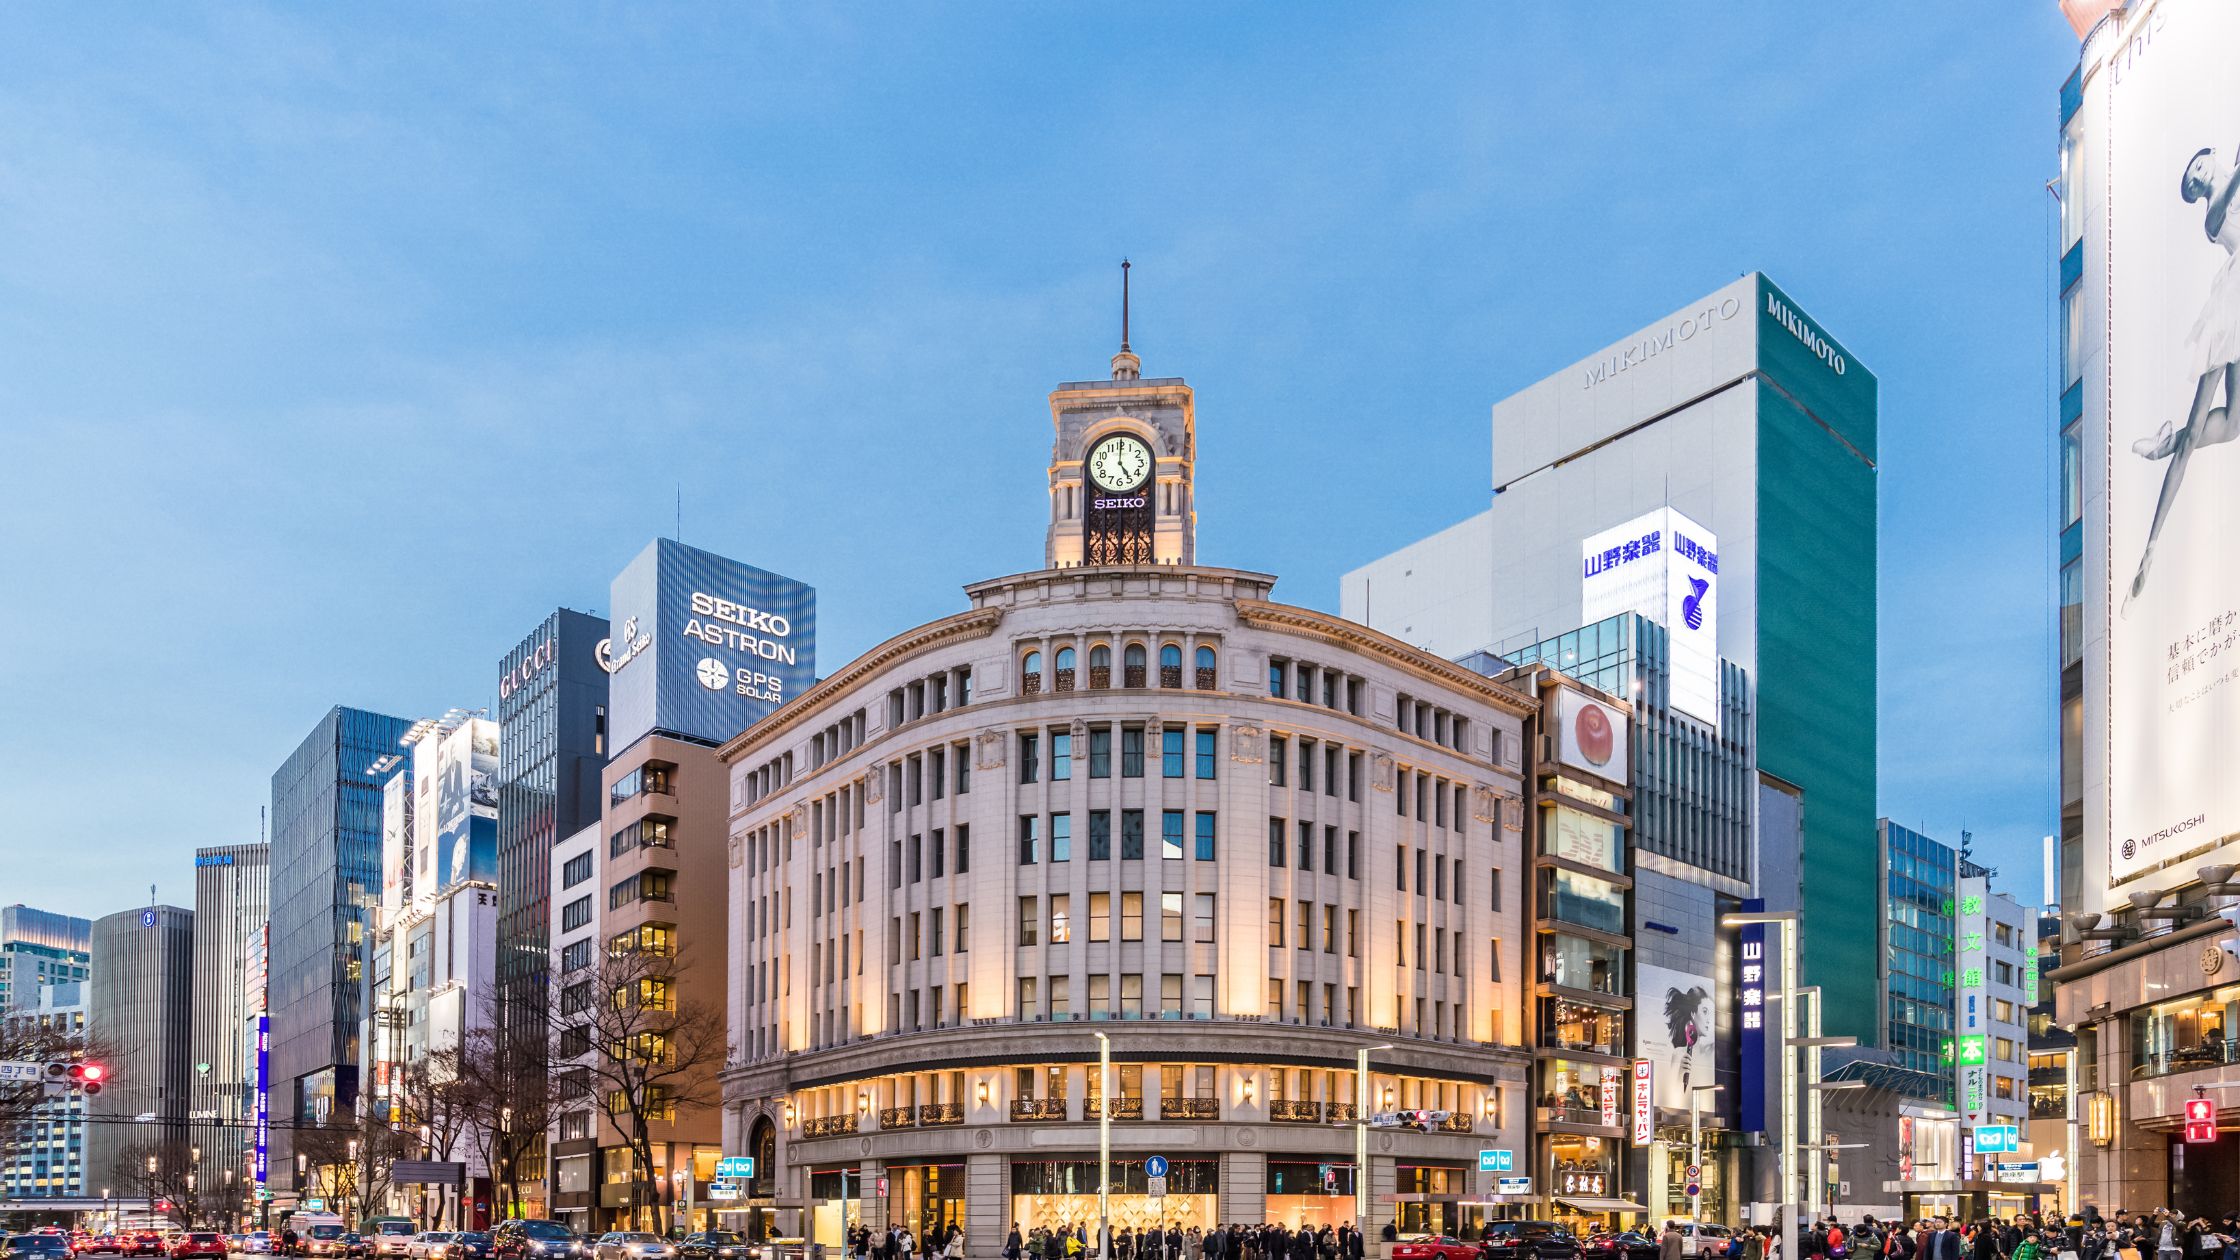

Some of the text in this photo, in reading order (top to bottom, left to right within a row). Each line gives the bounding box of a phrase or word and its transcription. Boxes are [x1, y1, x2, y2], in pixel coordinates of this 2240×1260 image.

[1583, 297, 1741, 389] MIKIMOTO
[1767, 292, 1846, 375] MIKIMOTO
[1099, 452, 1107, 460] 10
[1107, 444, 1114, 452] 11
[1135, 450, 1141, 458] 2
[1096, 461, 1103, 469] 9
[1099, 470, 1106, 478] 8
[1134, 468, 1141, 477] 4
[1138, 459, 1145, 468] 3
[1108, 476, 1114, 484] 7
[1116, 478, 1123, 486] 6
[1126, 475, 1133, 484] 5
[1094, 497, 1145, 509] SEIKO
[1584, 530, 1661, 578] 山野楽器
[1674, 530, 1719, 575] 山野楽器
[691, 592, 790, 637] SEIKO
[683, 619, 795, 666] ASTRON
[2168, 609, 2240, 661] 基本に磨か
[611, 646, 633, 674] Grand
[631, 632, 652, 657] Seiko
[2168, 629, 2240, 685] 信頼でかが
[500, 639, 551, 698] GUCCI
[736, 668, 782, 692] GPS
[736, 684, 782, 704] SOLAR
[2141, 813, 2205, 848] MITSUKOSHI
[1961, 895, 1982, 988] 教文館
[1743, 943, 1761, 1028] 山野楽器
[1962, 1039, 1982, 1061] 本
[1, 1065, 37, 1075] 四丁目
[189, 1110, 218, 1119] LUMINE
[1637, 1082, 1650, 1141] キムラヤのパン
